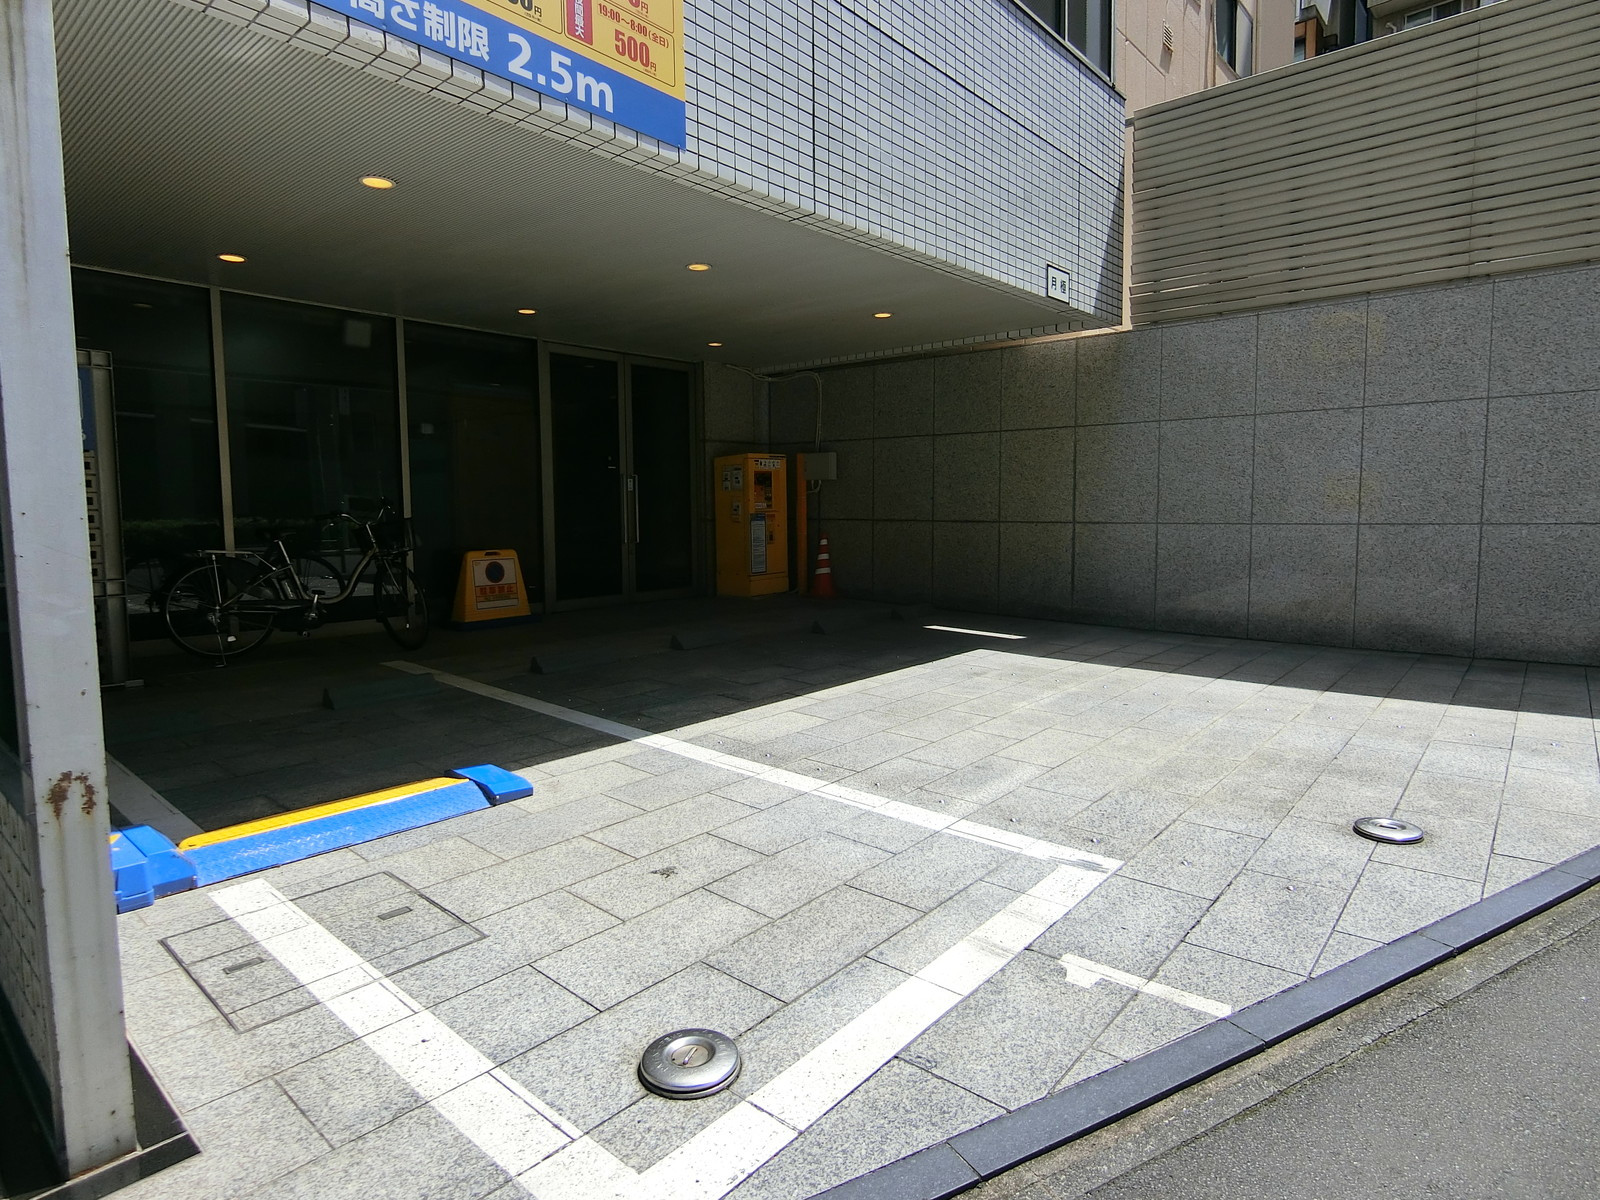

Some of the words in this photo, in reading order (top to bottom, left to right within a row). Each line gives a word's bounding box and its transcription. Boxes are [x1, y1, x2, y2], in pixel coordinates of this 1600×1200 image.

[574, 0, 585, 39] 間最大
[507, 33, 614, 114] 2.5m
